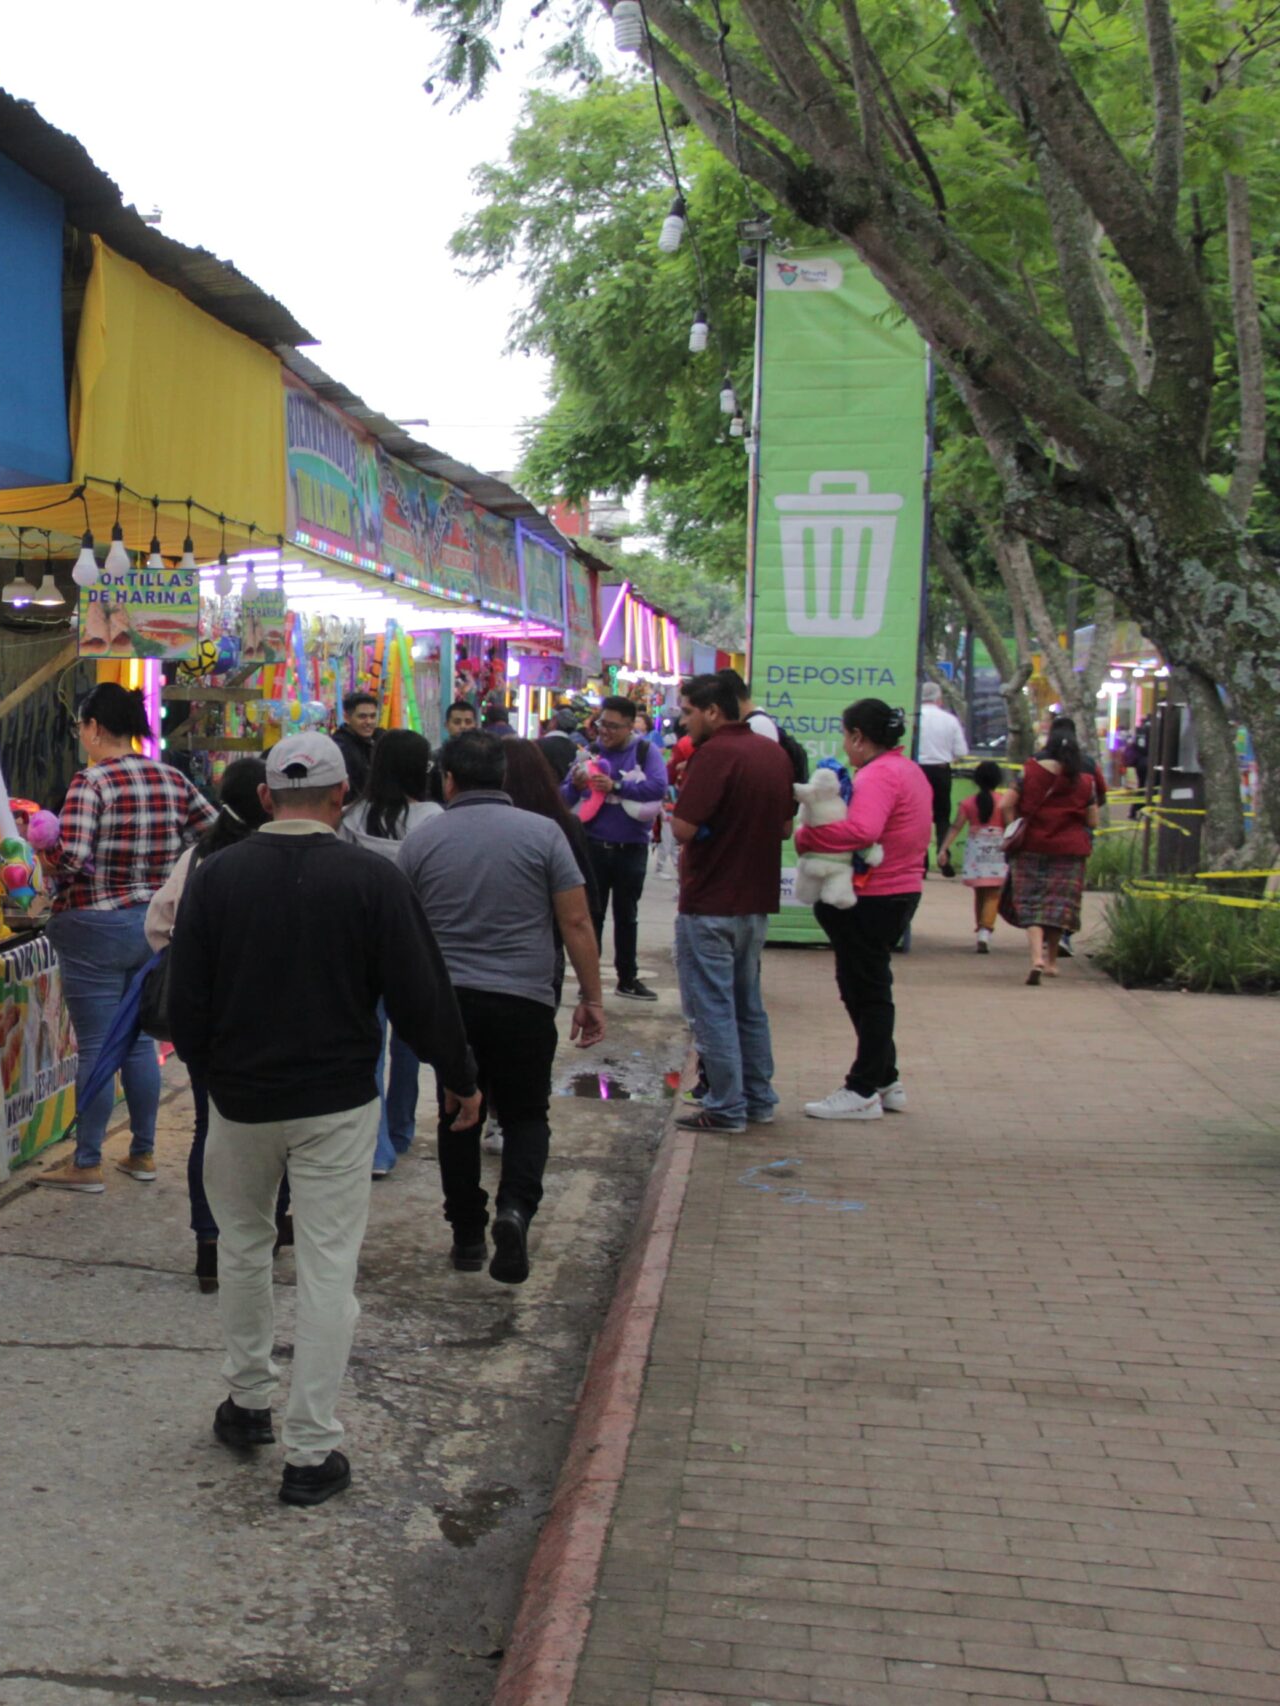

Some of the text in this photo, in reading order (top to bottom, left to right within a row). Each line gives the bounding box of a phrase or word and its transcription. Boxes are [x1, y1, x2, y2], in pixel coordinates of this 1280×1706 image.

[96, 572, 194, 587] ORTILLAS
[88, 590, 192, 605] DE HARINA
[767, 665, 896, 687] DEPOSITA
[766, 691, 794, 709] LA
